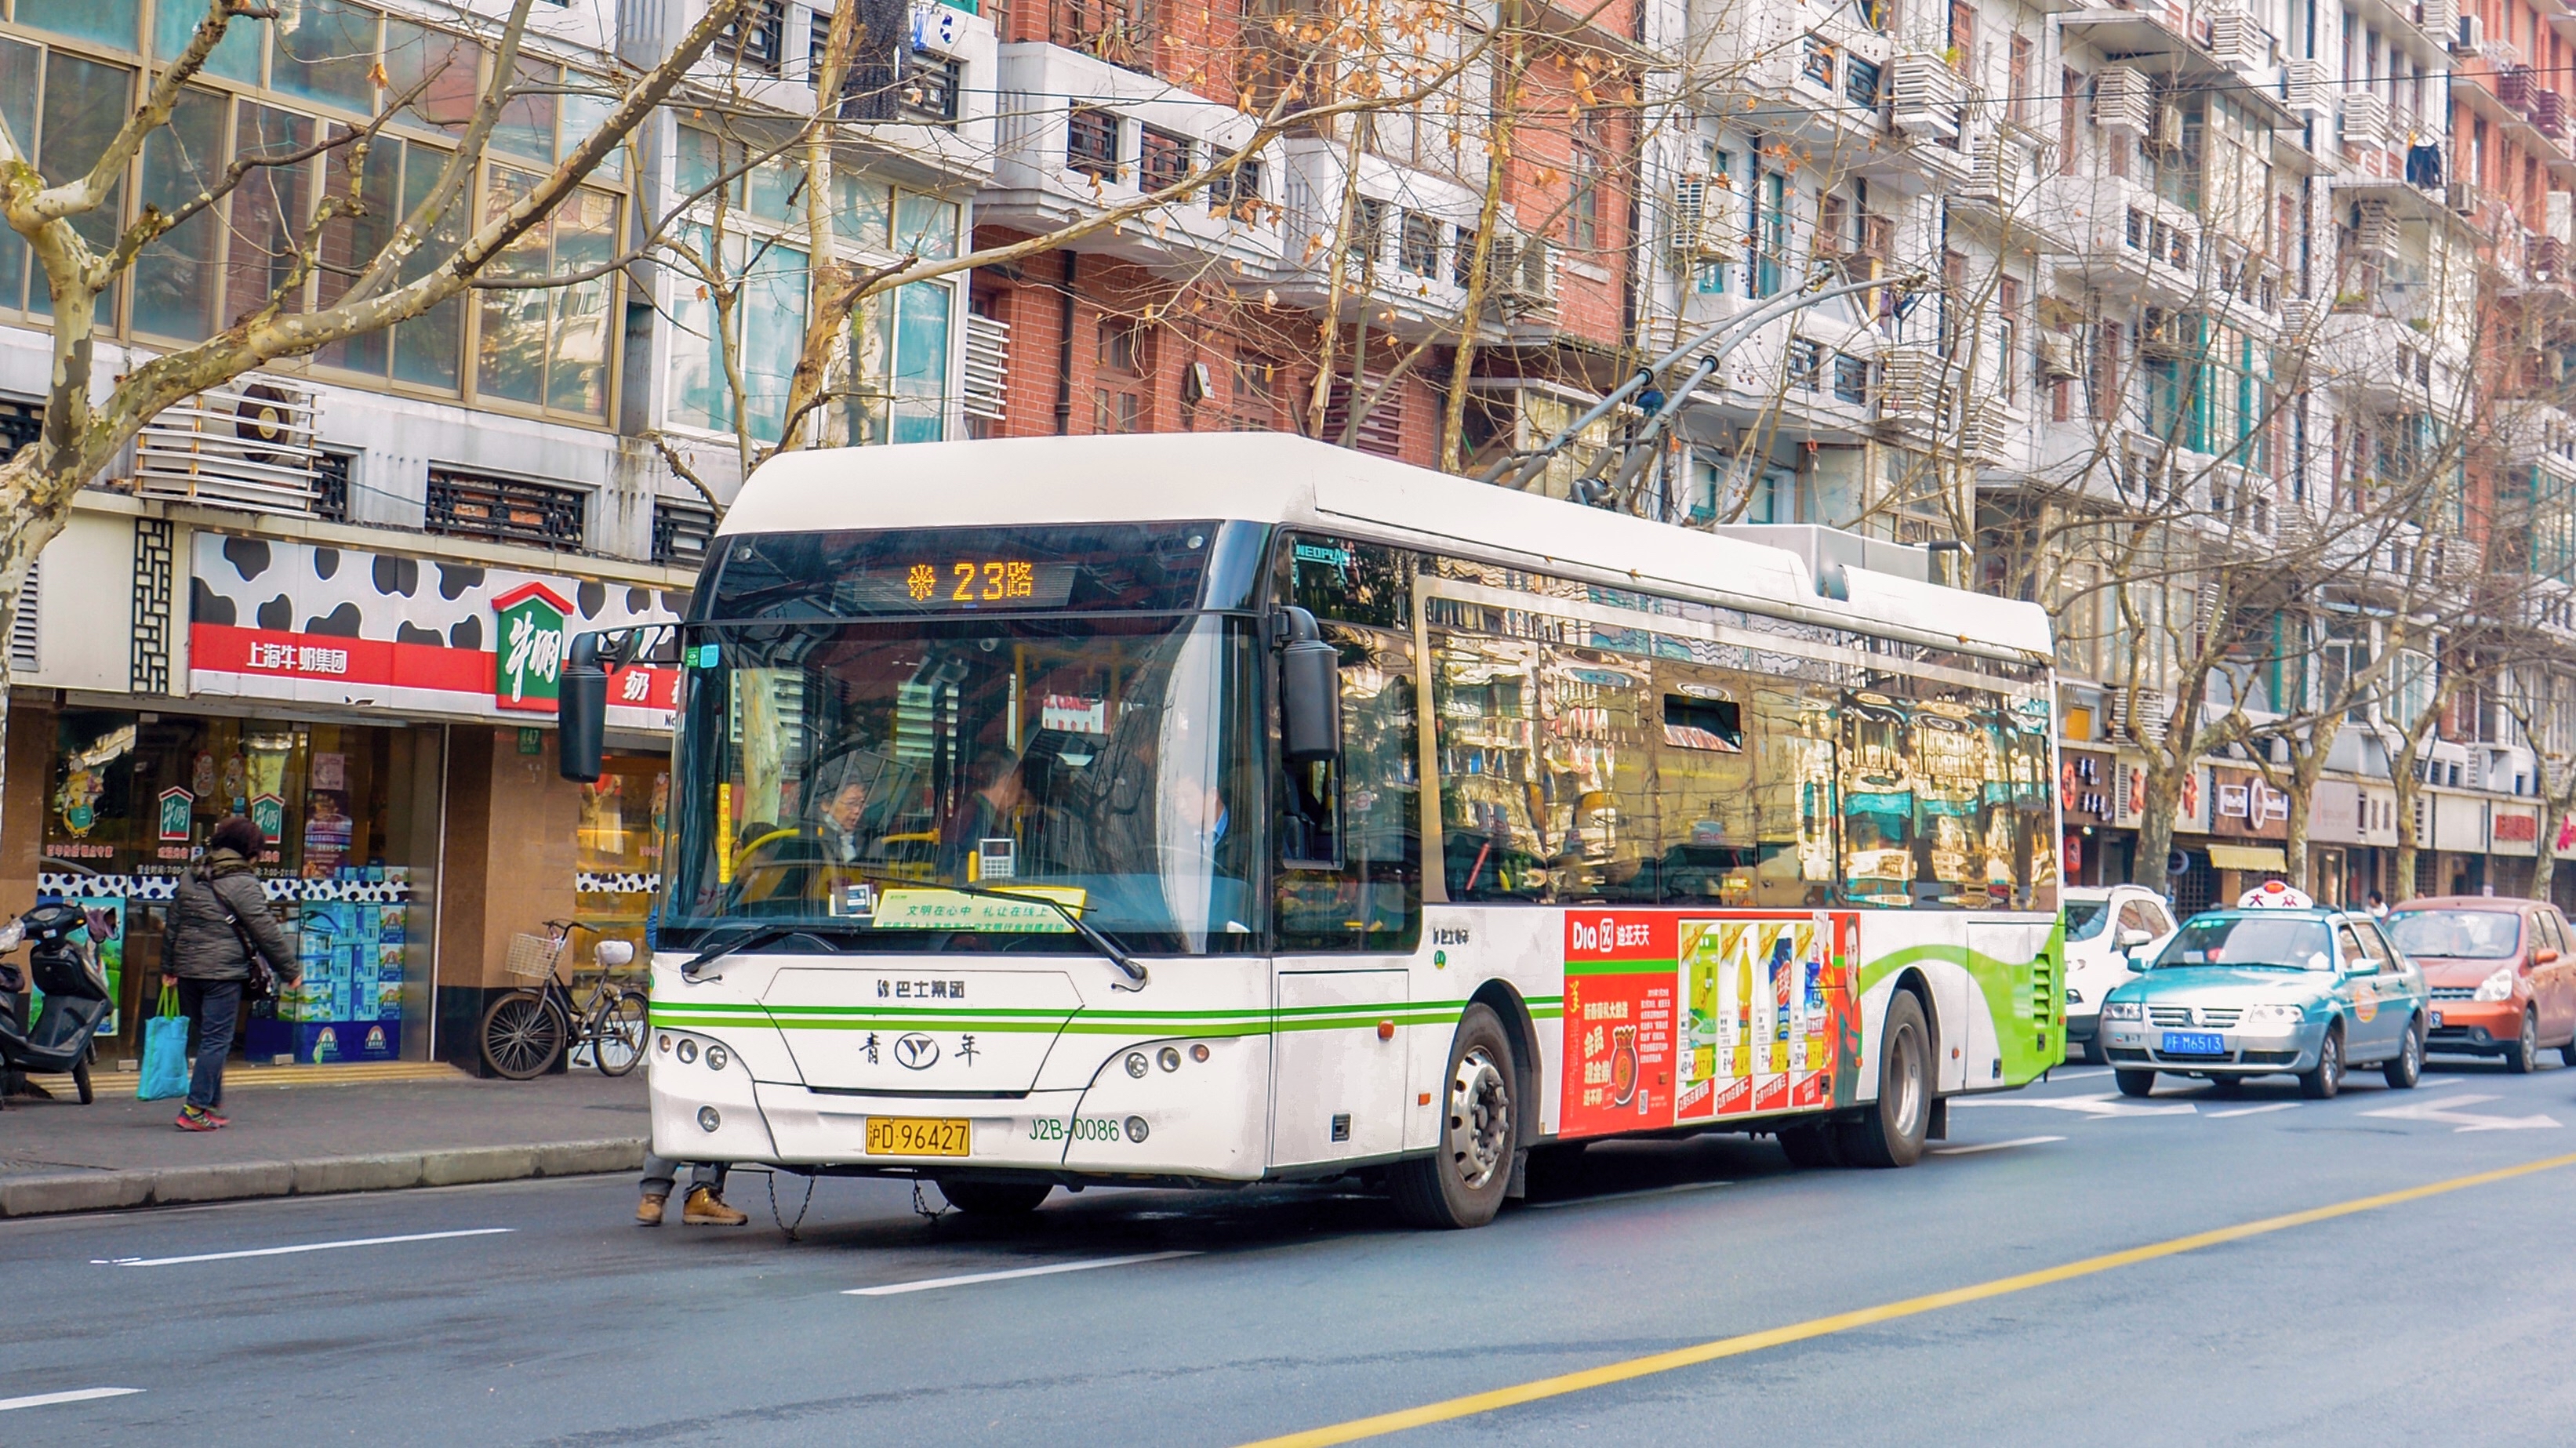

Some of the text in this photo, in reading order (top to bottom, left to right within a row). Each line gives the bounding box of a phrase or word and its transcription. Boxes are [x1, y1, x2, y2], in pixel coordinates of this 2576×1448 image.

[953, 561, 1033, 601] 23路
[246, 641, 347, 674] 上海牛奶集团
[907, 905, 1048, 917] 文明在心中 礼让在线上
[1616, 924, 1650, 946] 迪亚天天
[868, 1123, 968, 1150] 沪D·96427
[1029, 1118, 1120, 1142] J2B-0086
